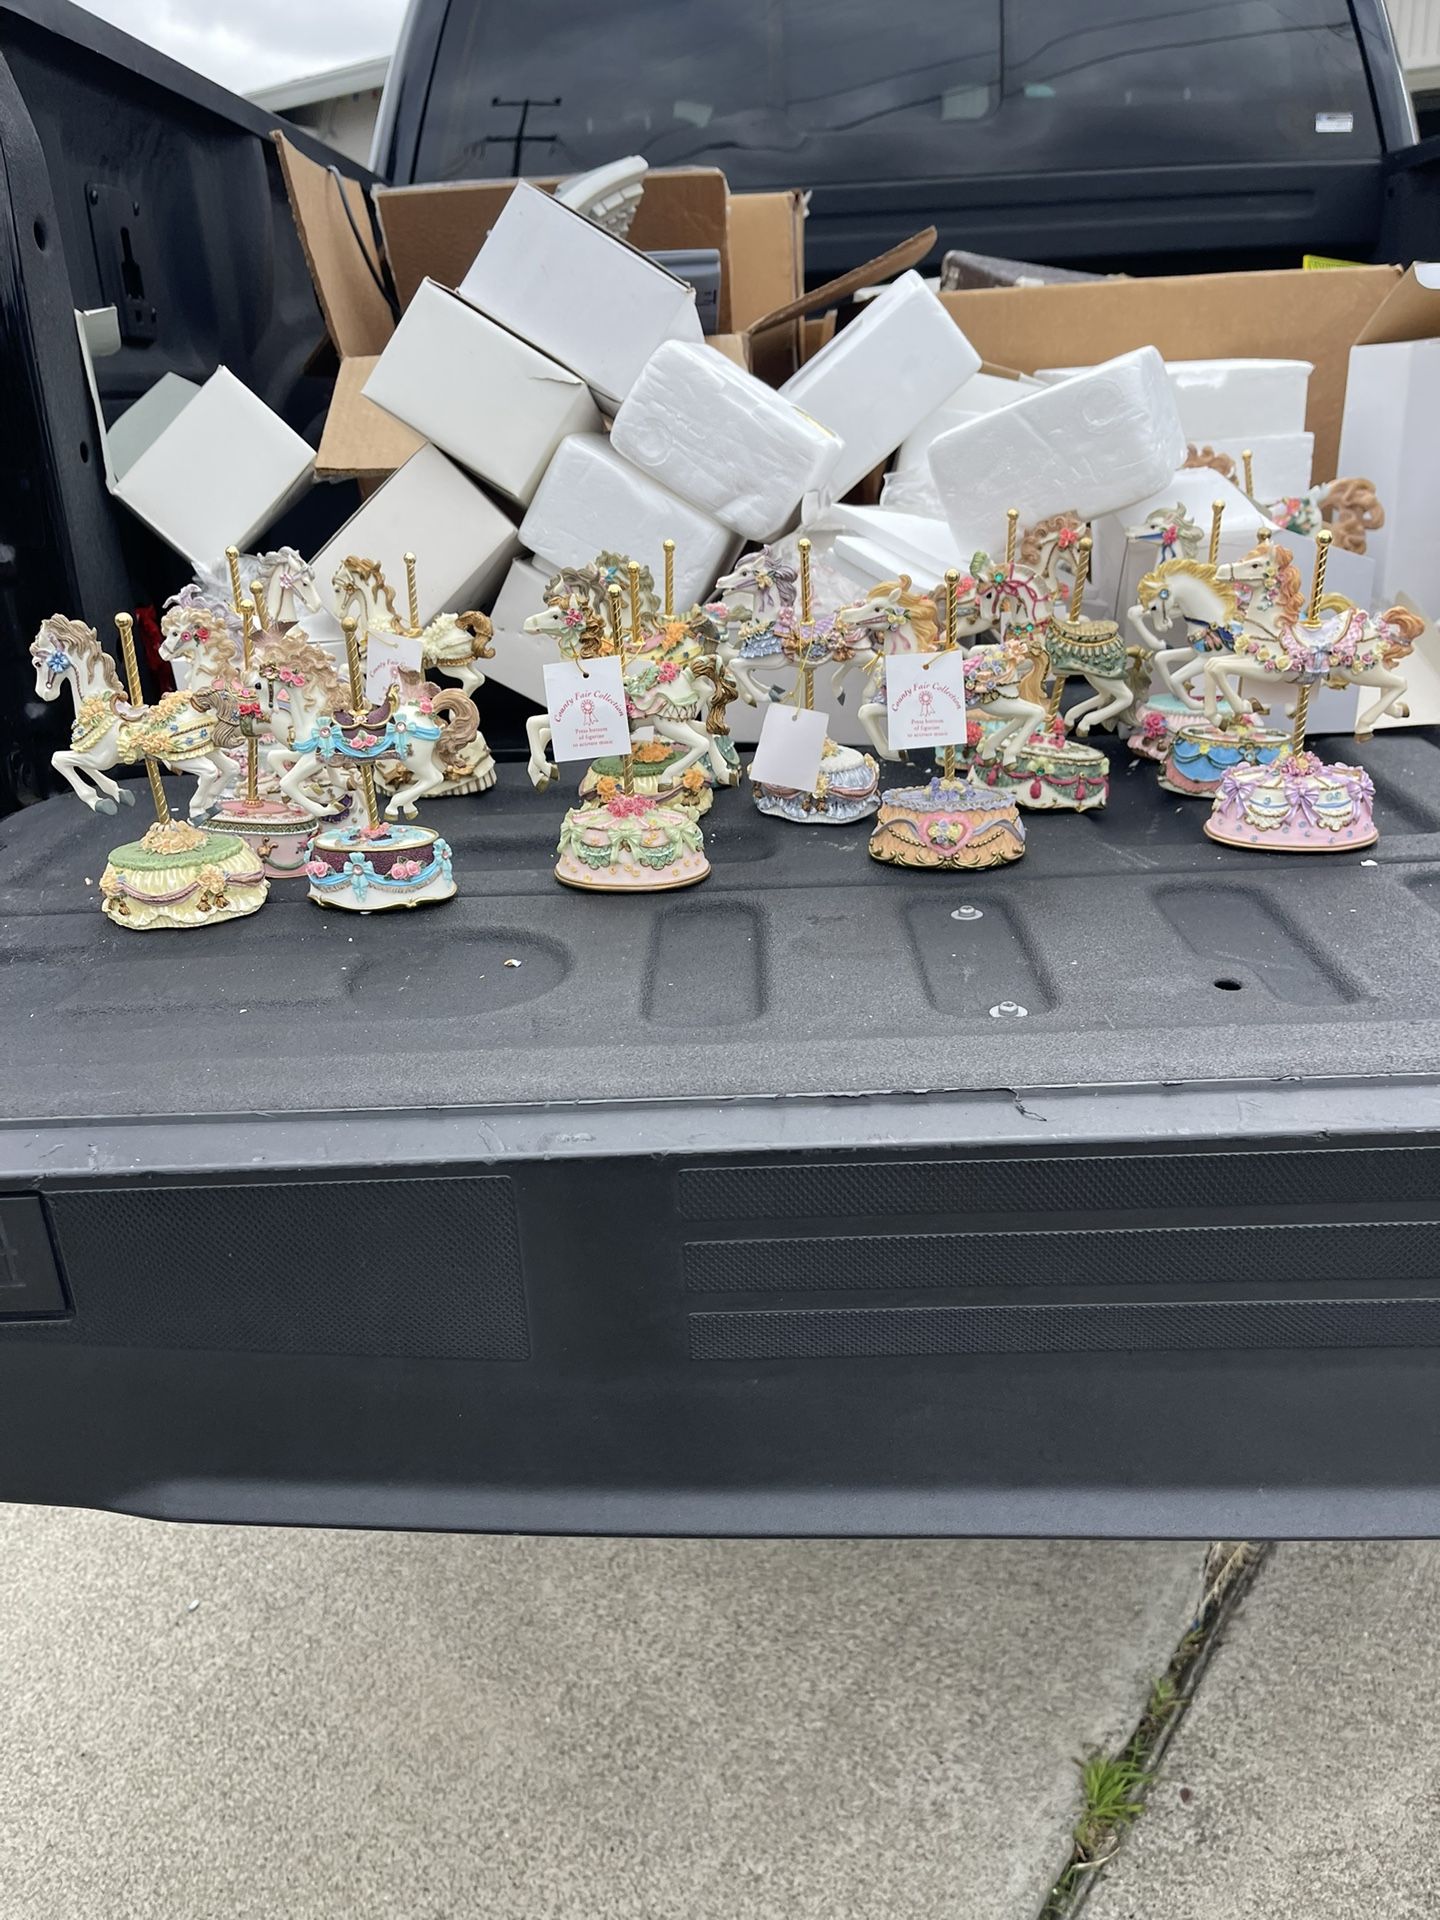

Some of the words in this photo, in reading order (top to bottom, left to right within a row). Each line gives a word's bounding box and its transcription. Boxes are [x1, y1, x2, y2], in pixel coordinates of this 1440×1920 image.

[554, 697, 574, 723] County
[575, 692, 592, 701] Fair
[593, 690, 624, 717] Collection
[891, 687, 912, 712] County
[913, 682, 930, 692] Fair
[932, 682, 961, 710] Collection
